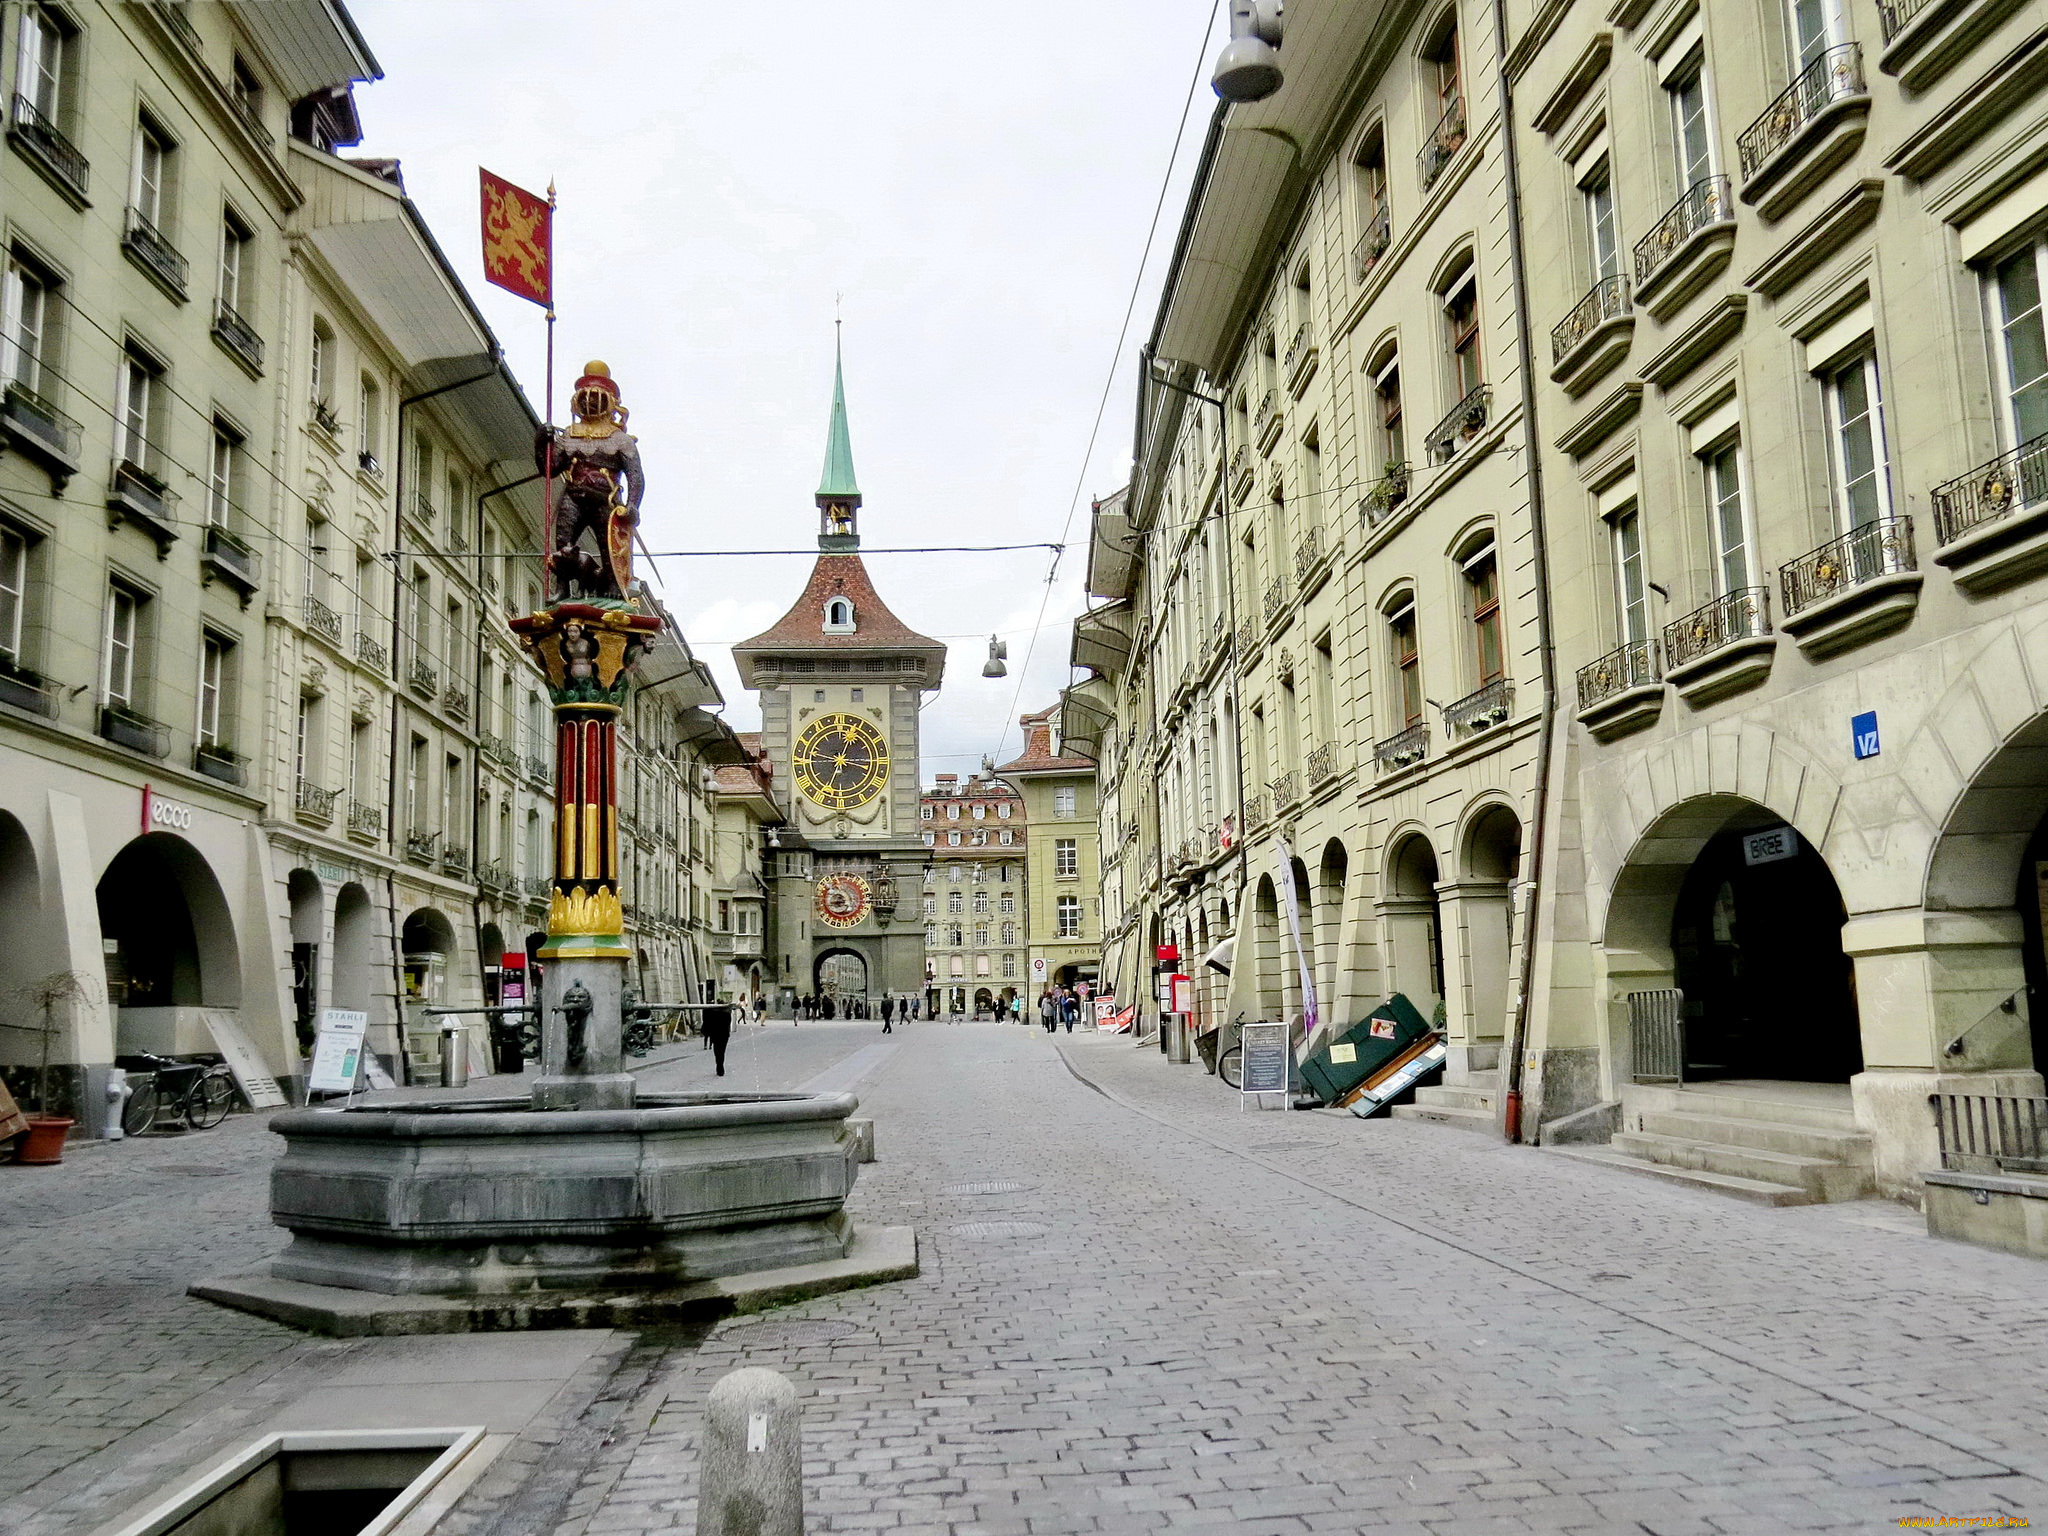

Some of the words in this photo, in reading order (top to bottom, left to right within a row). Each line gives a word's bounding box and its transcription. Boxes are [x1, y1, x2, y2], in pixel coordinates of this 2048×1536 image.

[1857, 730, 1879, 757] VZ
[152, 801, 192, 830] ecco
[1750, 834, 1784, 859] BREE
